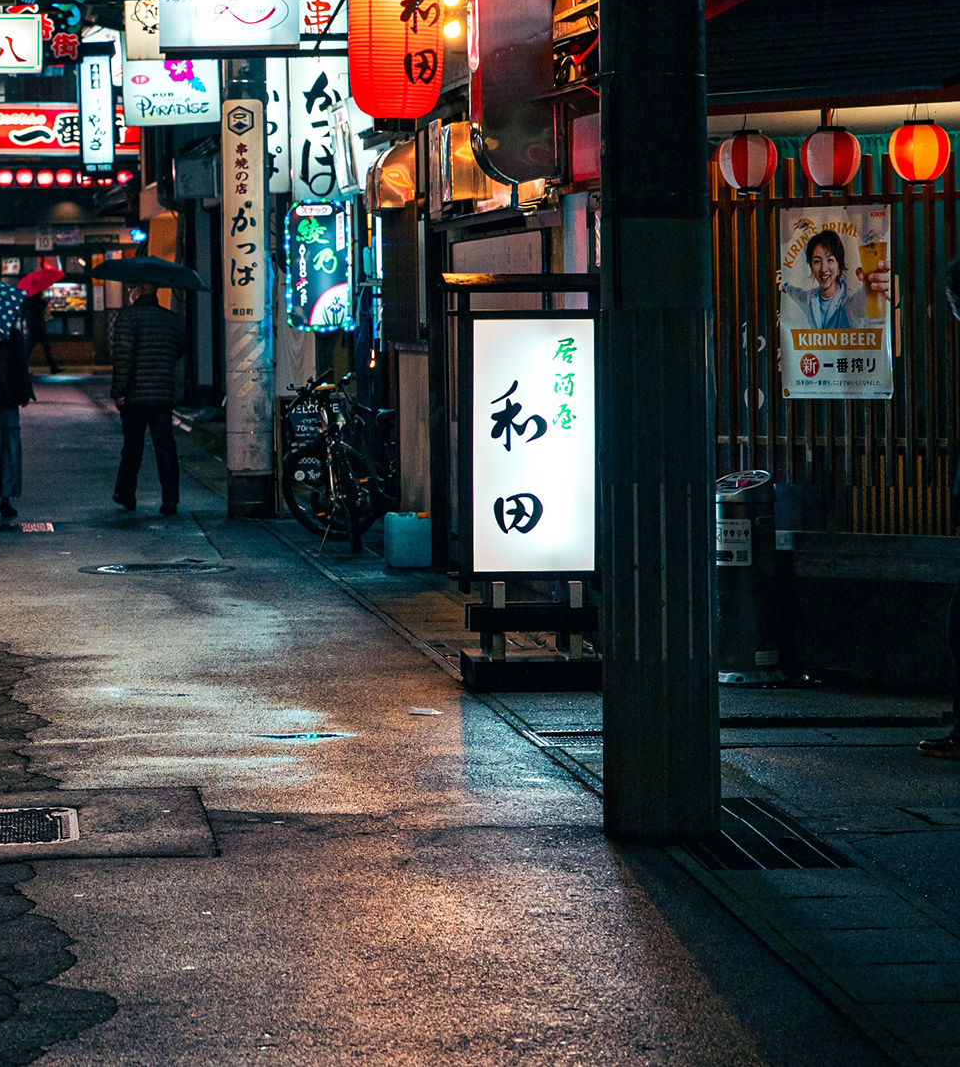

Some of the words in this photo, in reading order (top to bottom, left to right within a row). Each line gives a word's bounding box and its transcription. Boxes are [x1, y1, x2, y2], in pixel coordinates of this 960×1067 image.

[301, 205, 329, 215] スナック
[230, 200, 259, 288] かっぱ
[798, 332, 837, 346] KIRIN
[840, 332, 877, 346] BEER
[551, 337, 577, 430] 居酒屋
[802, 357, 817, 374] 新
[822, 357, 876, 373] 一番搾り
[490, 380, 548, 534] 和田
